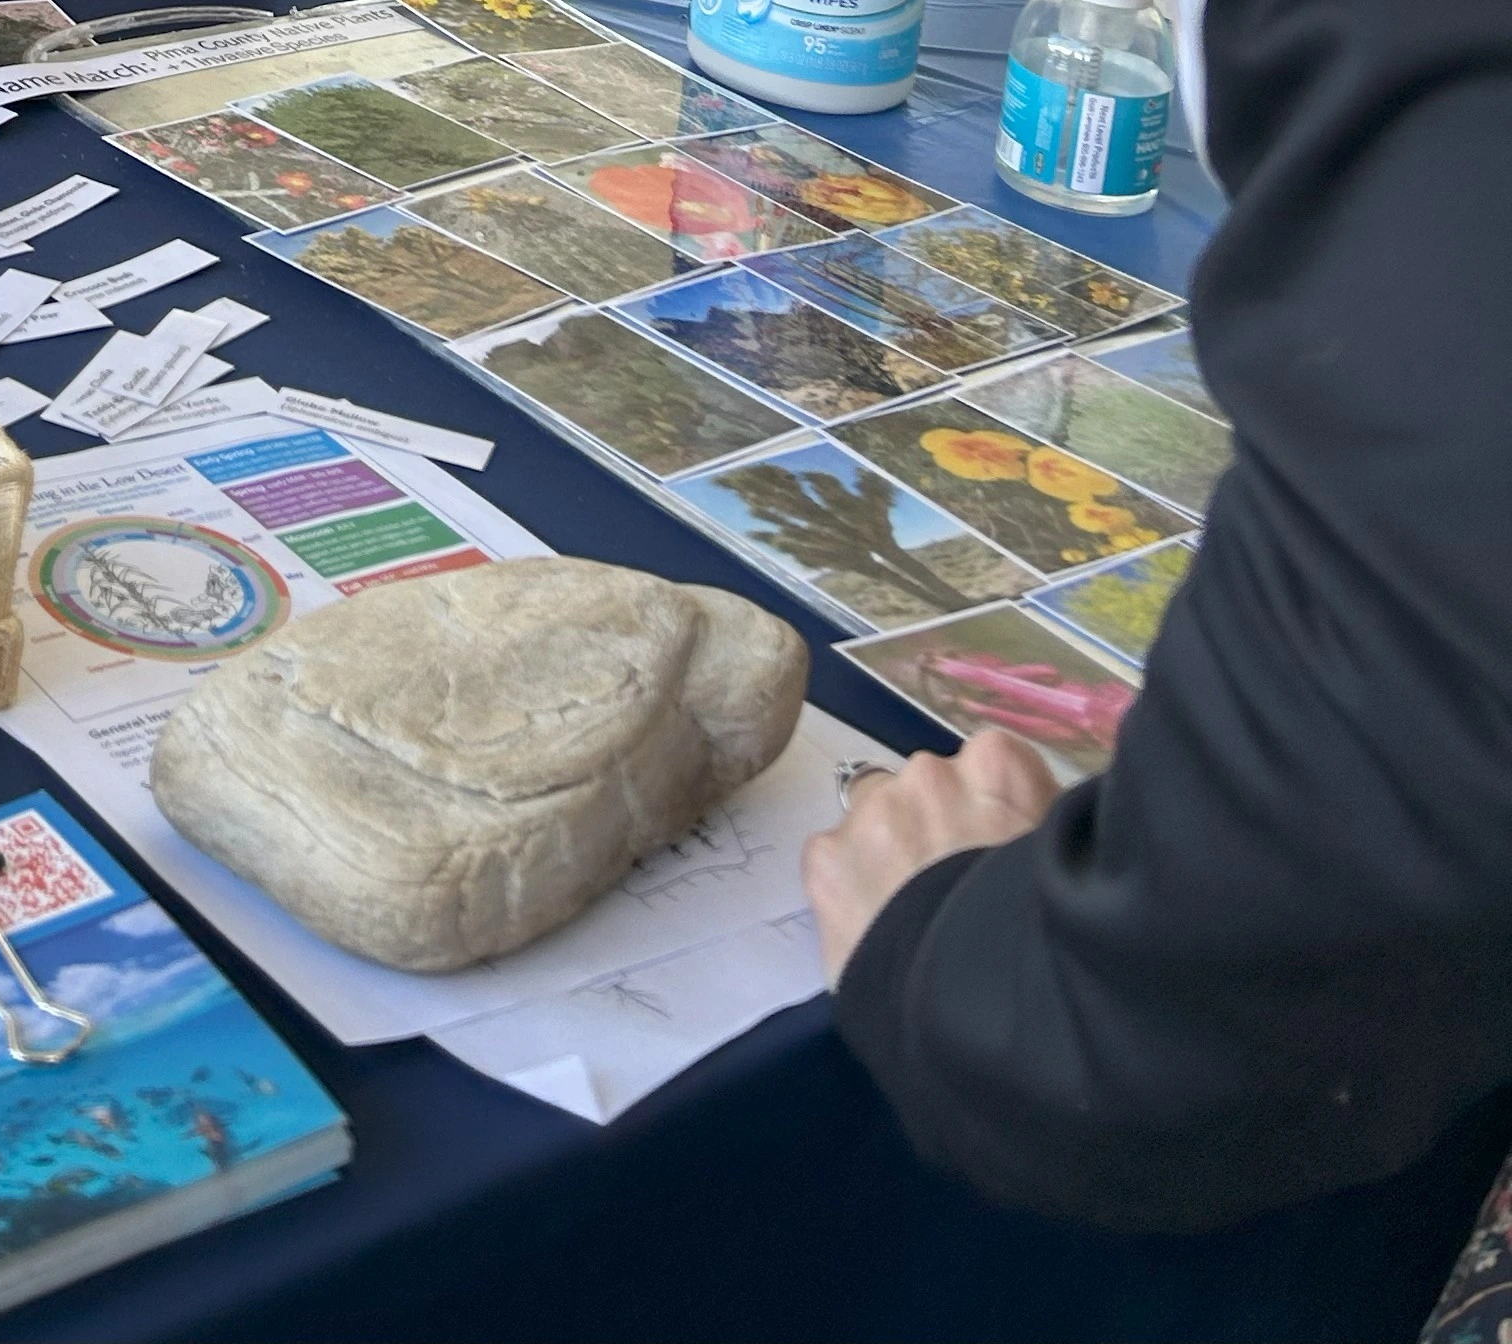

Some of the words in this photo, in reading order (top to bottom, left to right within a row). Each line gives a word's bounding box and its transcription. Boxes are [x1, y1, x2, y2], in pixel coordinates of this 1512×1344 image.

[68, 60, 157, 86] Match:
[144, 38, 196, 63] Pima
[197, 29, 269, 55] County
[270, 20, 330, 44] Native
[331, 7, 396, 32] Plants
[194, 43, 274, 68] Invasive
[276, 30, 347, 55] Species
[803, 35, 827, 55] 95
[77, 480, 101, 493] the
[102, 474, 136, 488] Low
[137, 463, 186, 480] Desert
[88, 715, 142, 739] General
